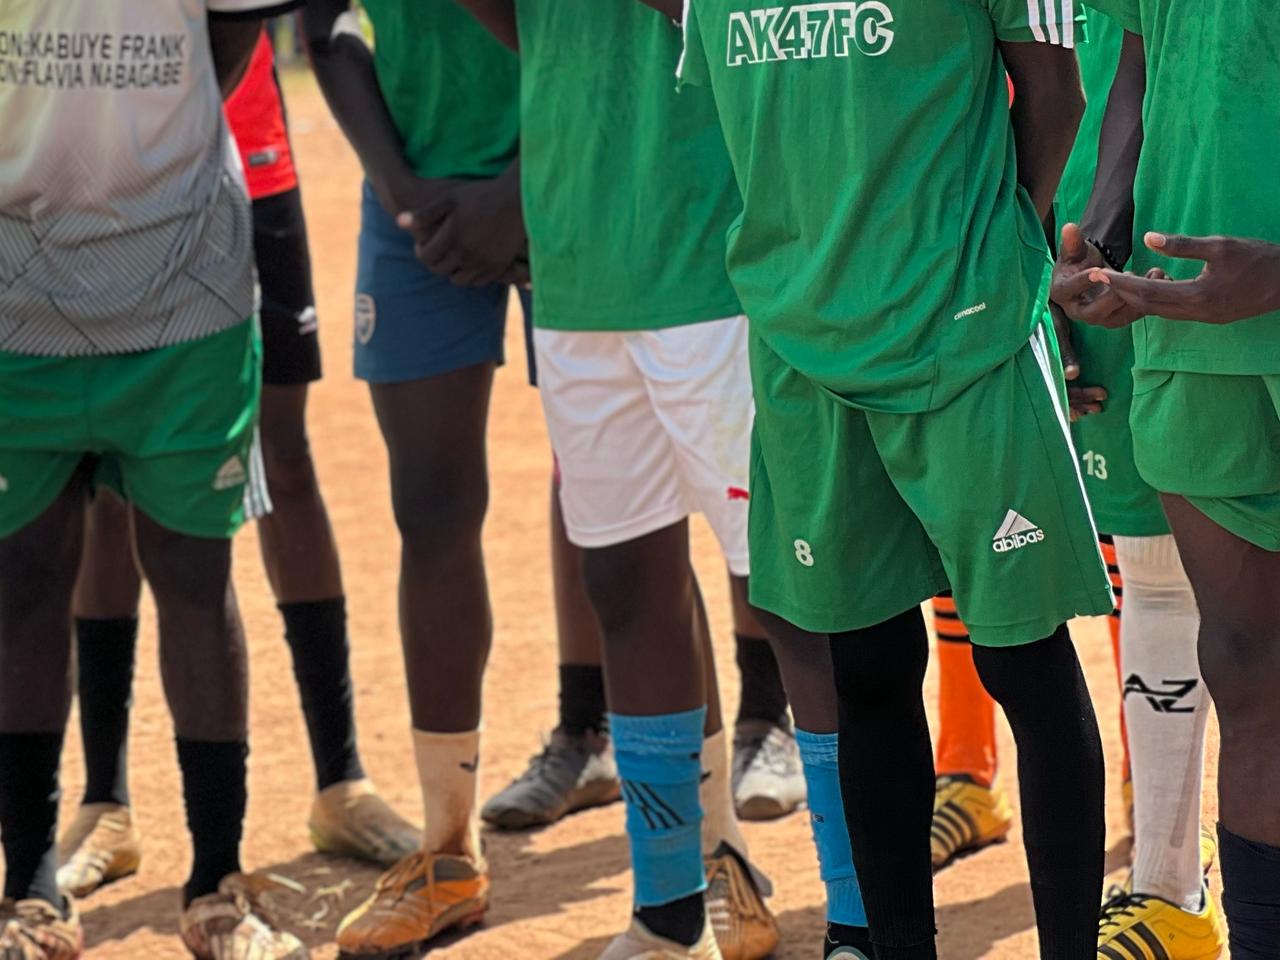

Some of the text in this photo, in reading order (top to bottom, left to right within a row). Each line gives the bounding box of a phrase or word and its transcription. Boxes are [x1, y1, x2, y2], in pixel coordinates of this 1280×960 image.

[119, 34, 185, 60] FRANK
[726, 0, 895, 67] AK47FC
[1082, 449, 1108, 480] 13
[793, 538, 815, 567] 8
